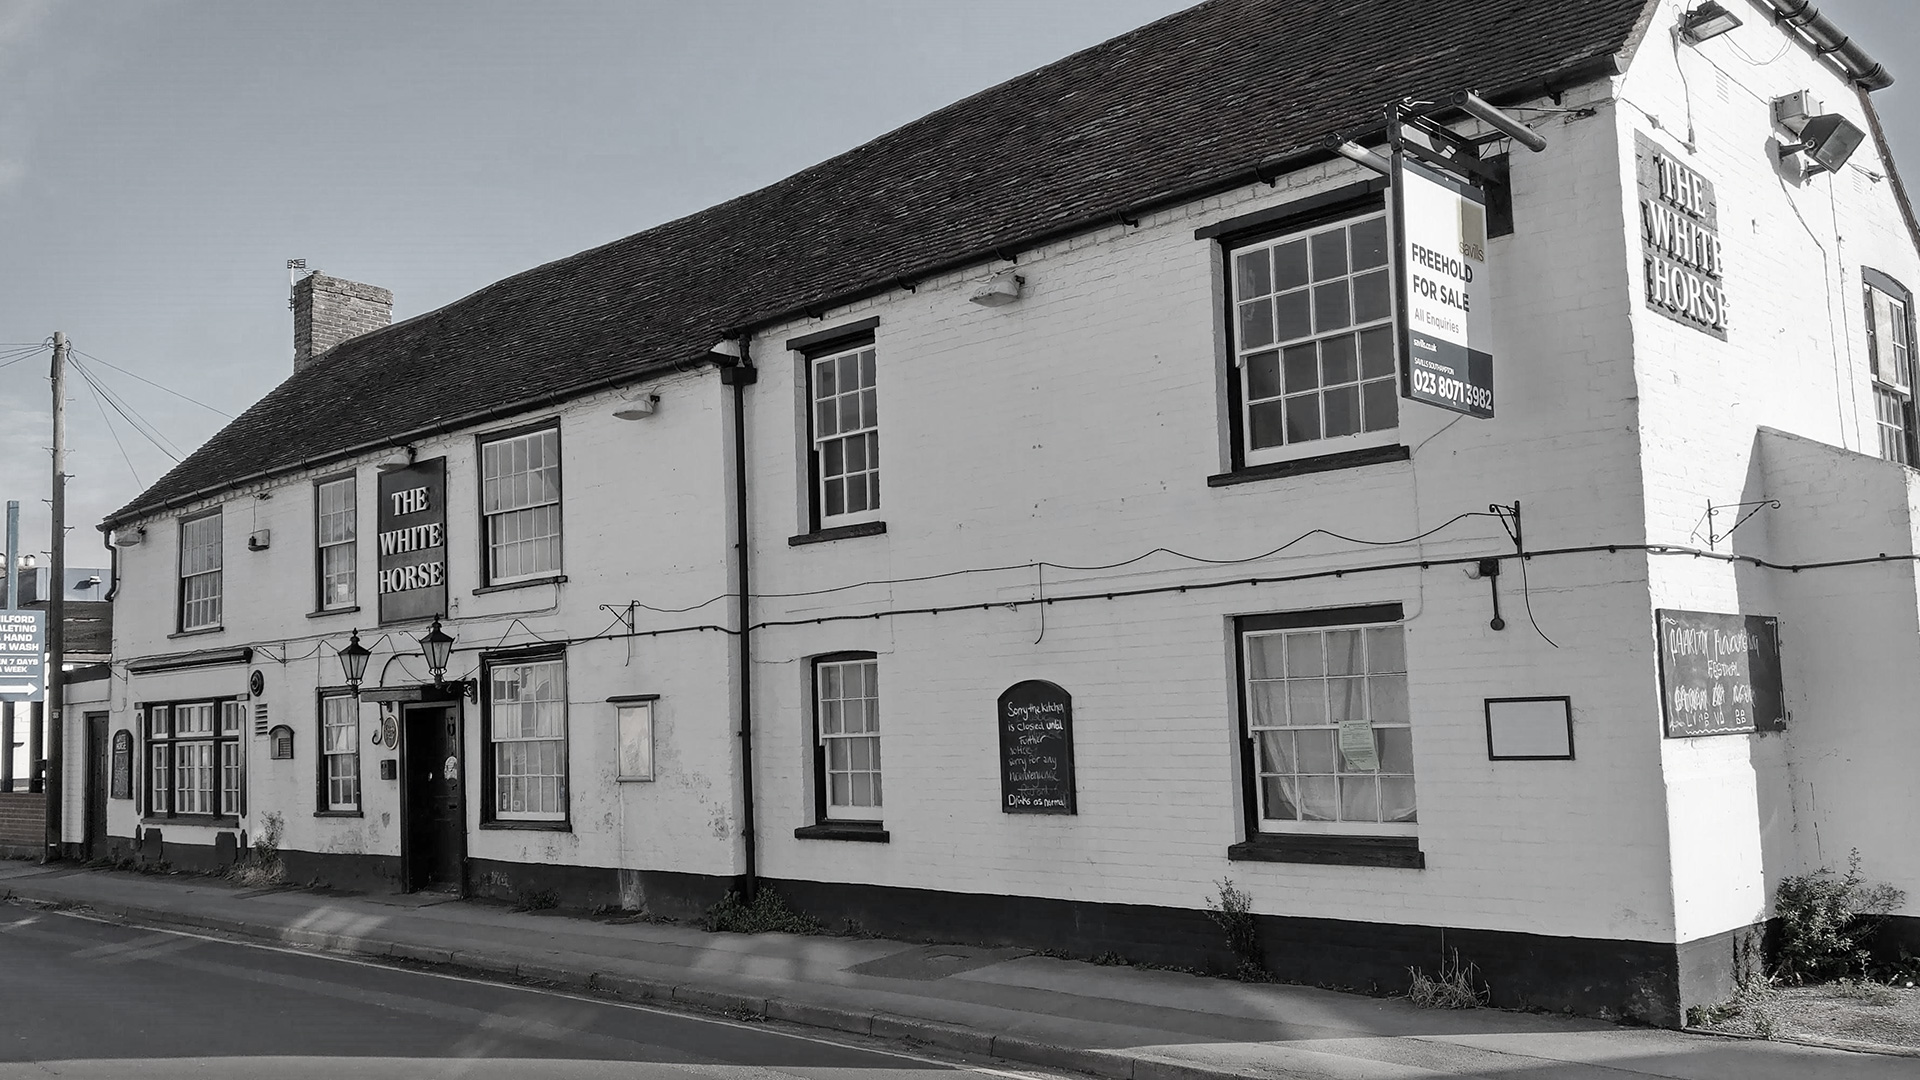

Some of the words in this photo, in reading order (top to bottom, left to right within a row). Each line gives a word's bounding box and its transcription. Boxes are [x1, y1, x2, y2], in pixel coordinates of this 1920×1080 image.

[1658, 153, 1706, 218] THE
[1459, 240, 1485, 262] savills
[1646, 199, 1724, 278] WHITE
[1411, 242, 1474, 284] FREEHOLD
[1412, 274, 1438, 302] FOR
[1440, 286, 1470, 313] SALE
[1651, 256, 1730, 331] HORSE
[1414, 308, 1425, 321] All
[1426, 312, 1460, 334] Enquiries
[1413, 368, 1437, 395] 023
[1438, 375, 1464, 405] 8071
[1466, 384, 1493, 411] 3982
[391, 486, 429, 516] THE
[379, 523, 443, 556] WHITE
[379, 561, 443, 594] HORSE
[0, 615, 35, 623] ILFORD
[4, 633, 33, 642] HAND
[9, 643, 39, 651] WASH
[1007, 701, 1029, 720] Sorry
[1028, 703, 1041, 714] the
[1008, 720, 1015, 732] is
[1016, 721, 1045, 732] closed
[1046, 719, 1064, 730] until
[1043, 756, 1058, 770] any
[1033, 798, 1043, 806] as
